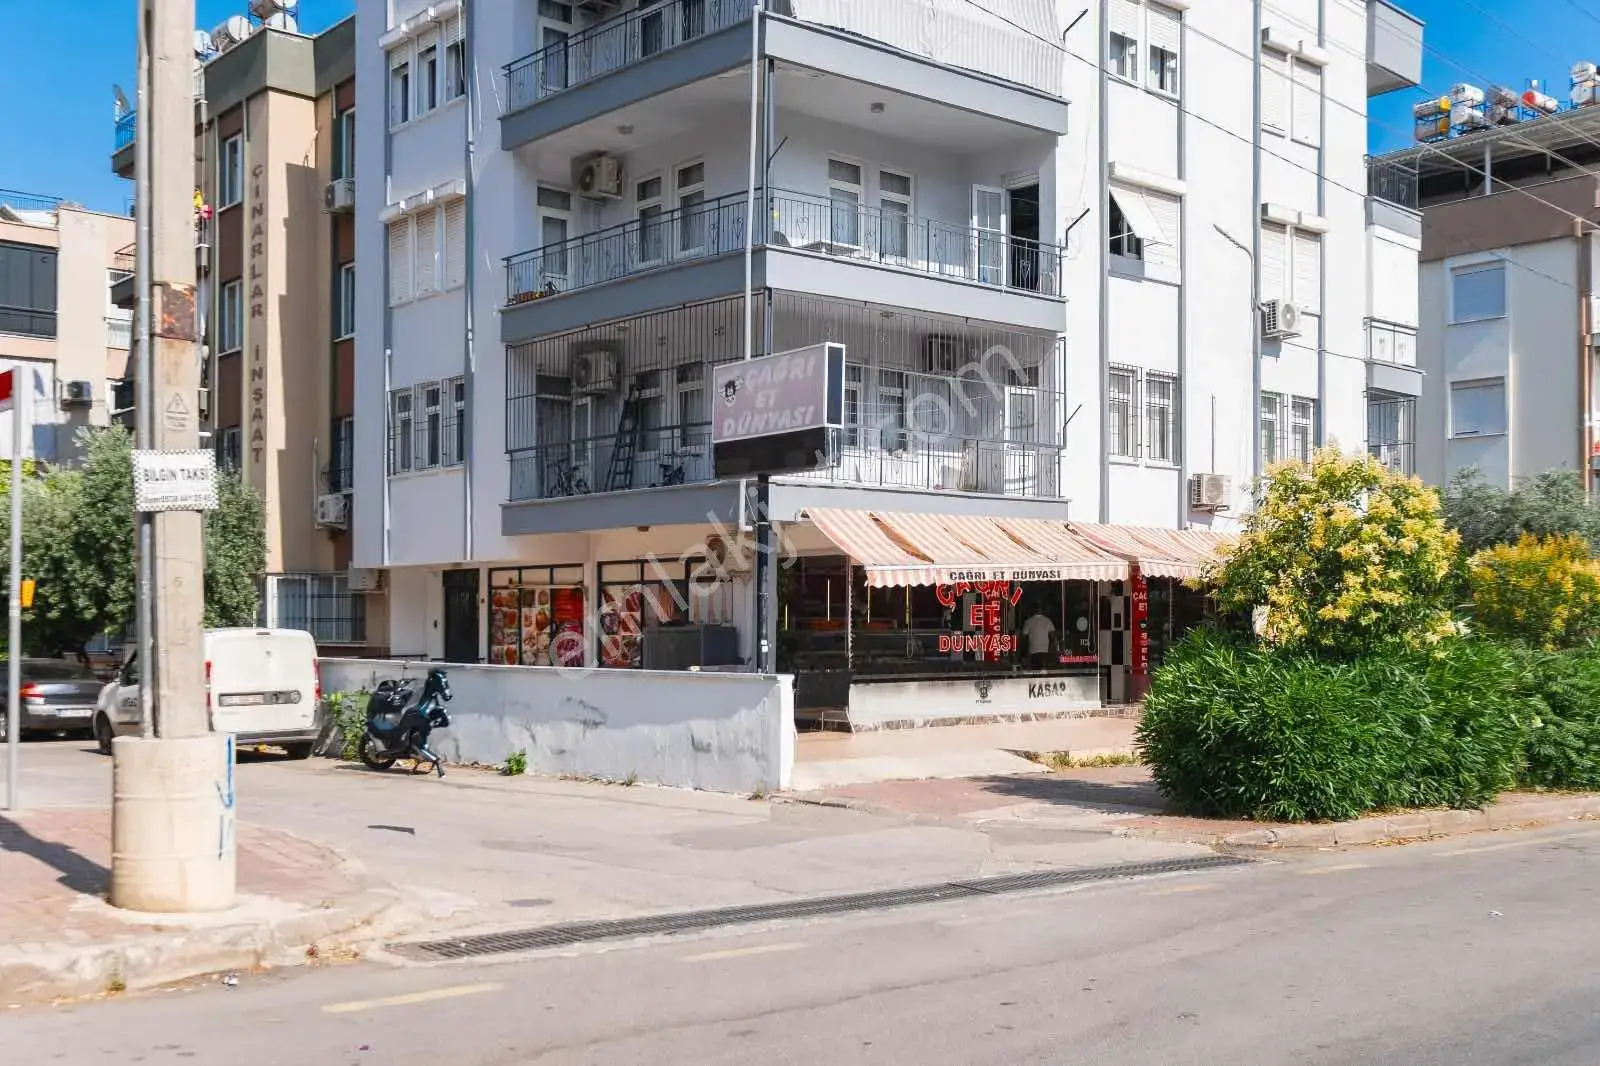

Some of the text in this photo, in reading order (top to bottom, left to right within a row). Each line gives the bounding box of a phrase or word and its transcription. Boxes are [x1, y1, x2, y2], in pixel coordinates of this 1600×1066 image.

[755, 388, 779, 409] ET
[722, 405, 815, 437] DÜNYASI
[971, 604, 1001, 626] ET
[939, 630, 1018, 653] DÜNYASI
[1028, 681, 1066, 699] KASAP
